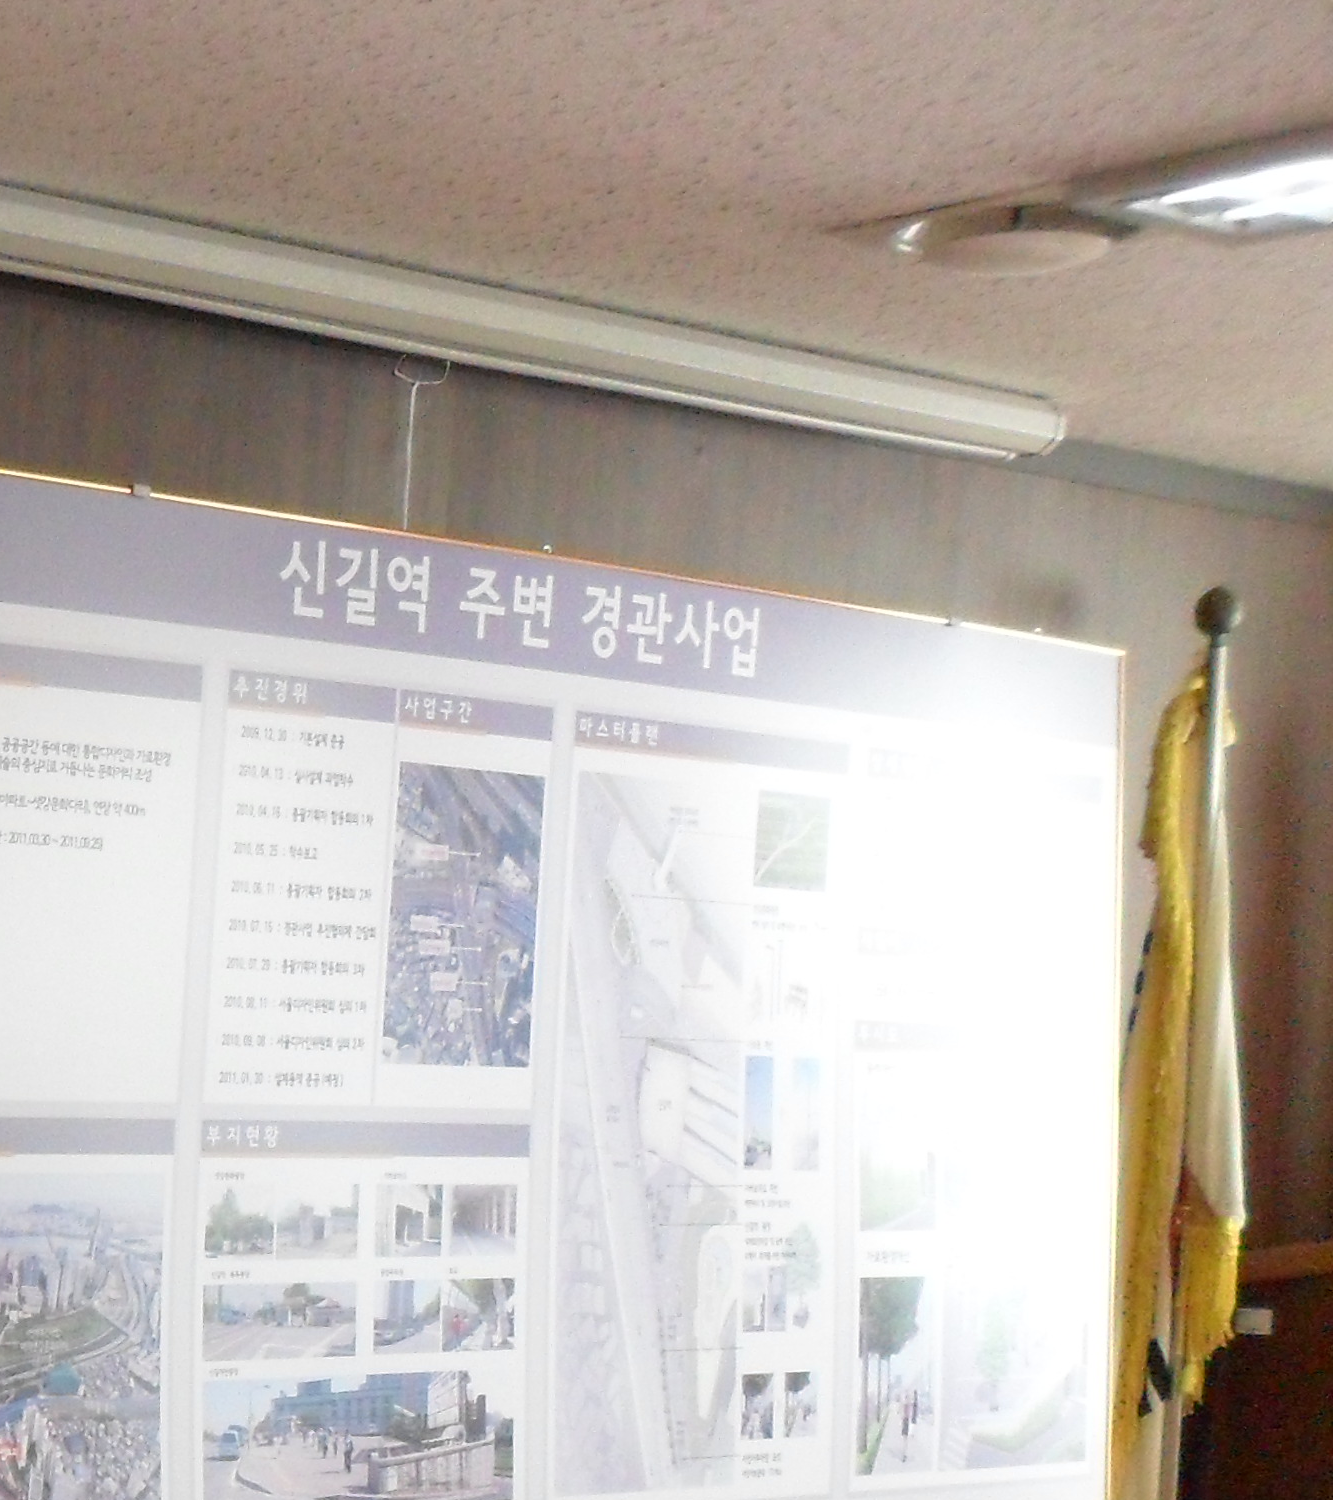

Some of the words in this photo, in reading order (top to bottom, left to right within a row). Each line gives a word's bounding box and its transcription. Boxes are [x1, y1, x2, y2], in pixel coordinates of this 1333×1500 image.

[279, 540, 431, 634] 신길역
[459, 567, 554, 649] 주변
[581, 585, 764, 682] 경관사업
